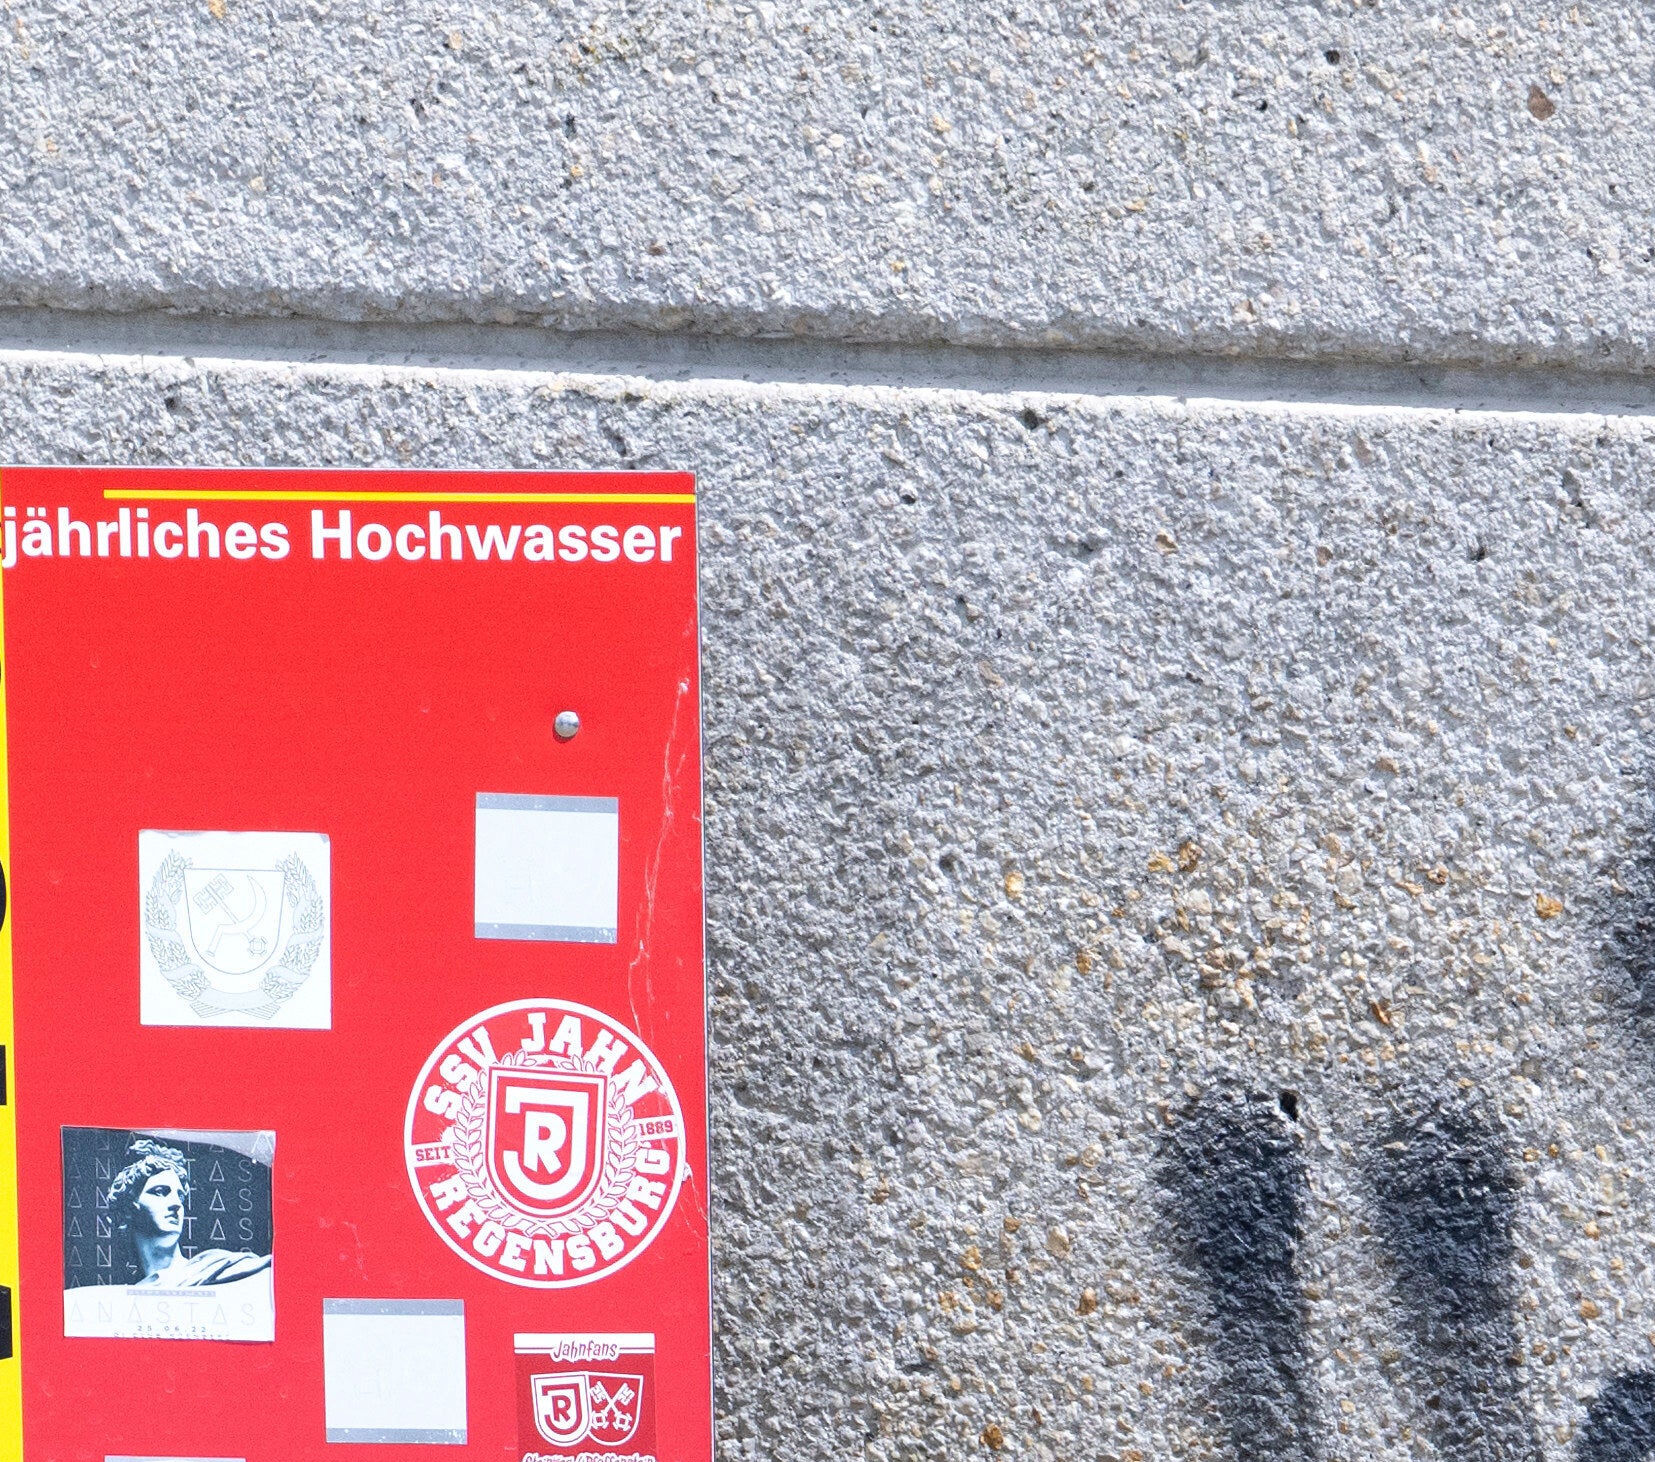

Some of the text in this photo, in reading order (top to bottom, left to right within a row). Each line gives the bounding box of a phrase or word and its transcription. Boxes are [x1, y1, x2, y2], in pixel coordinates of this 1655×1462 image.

[310, 510, 684, 563] Hochwasser
[423, 1012, 658, 1120] SSV JAHN
[639, 1120, 673, 1135] 1889
[416, 1146, 450, 1161] SEIT
[429, 1147, 670, 1274] REGENSBURG
[553, 1341, 618, 1359] Jahnfans
